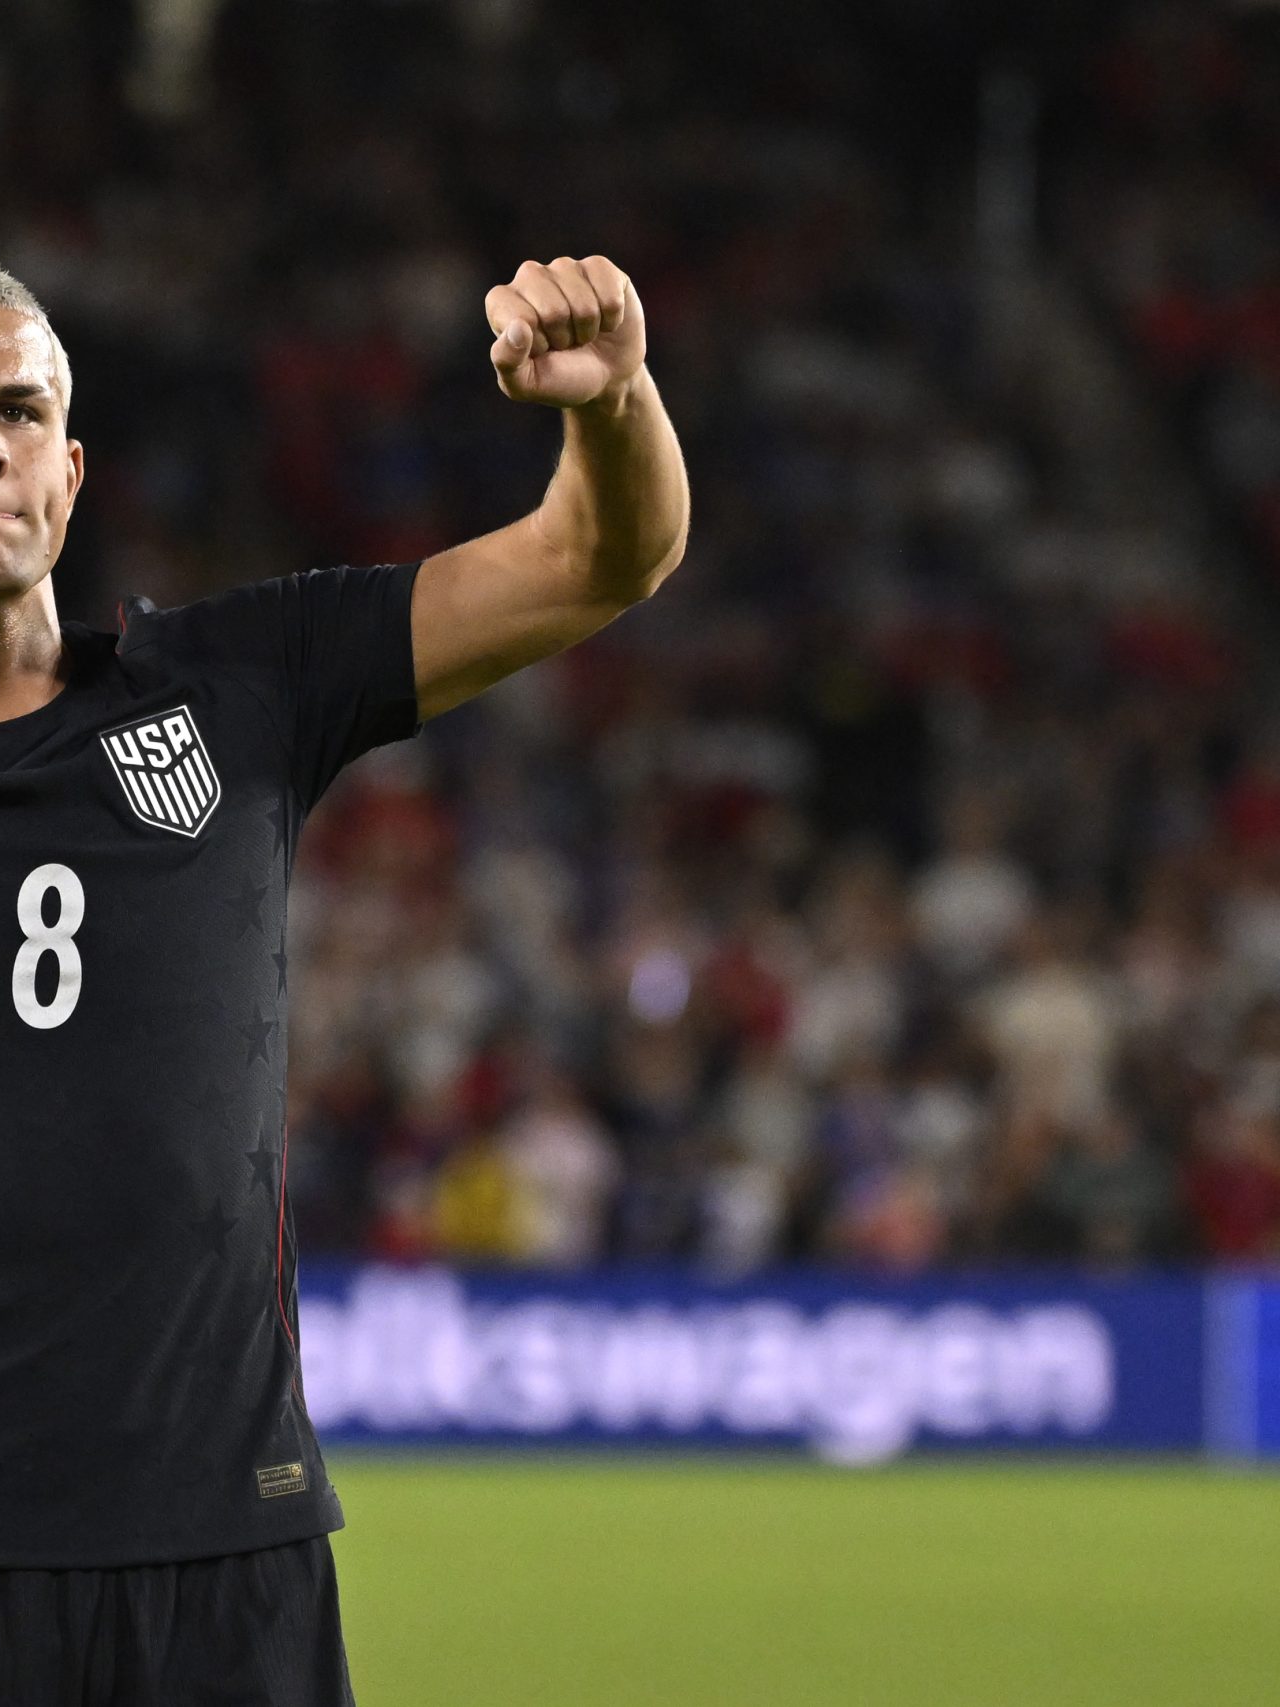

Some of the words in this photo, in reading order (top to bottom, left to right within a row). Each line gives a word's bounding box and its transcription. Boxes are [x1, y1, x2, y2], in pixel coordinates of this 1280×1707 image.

[108, 714, 193, 769] USA
[11, 863, 85, 1030] 8
[297, 1266, 1113, 1466] olkswagen
